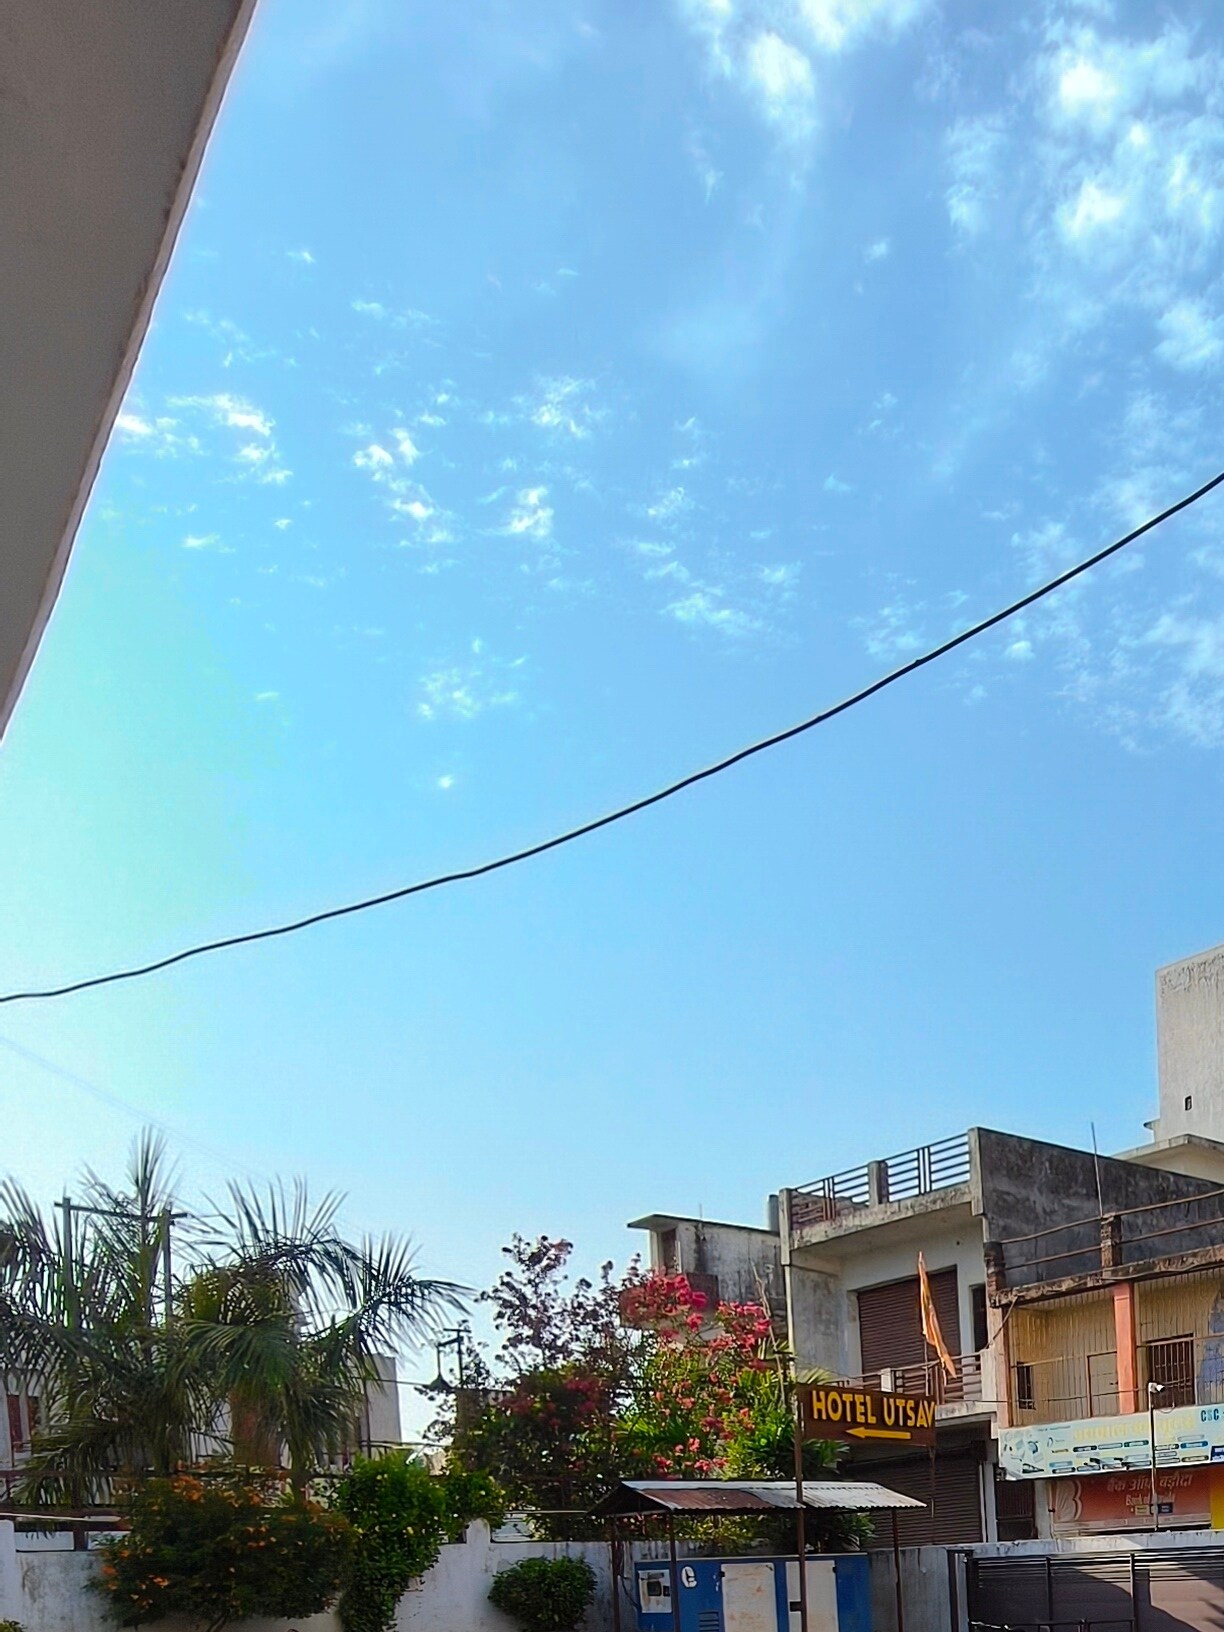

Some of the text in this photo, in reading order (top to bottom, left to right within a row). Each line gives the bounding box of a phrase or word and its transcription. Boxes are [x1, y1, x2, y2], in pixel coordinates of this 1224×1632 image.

[812, 1389, 936, 1428] HOTEL UTSAV
[1200, 1408, 1220, 1422] CSC
